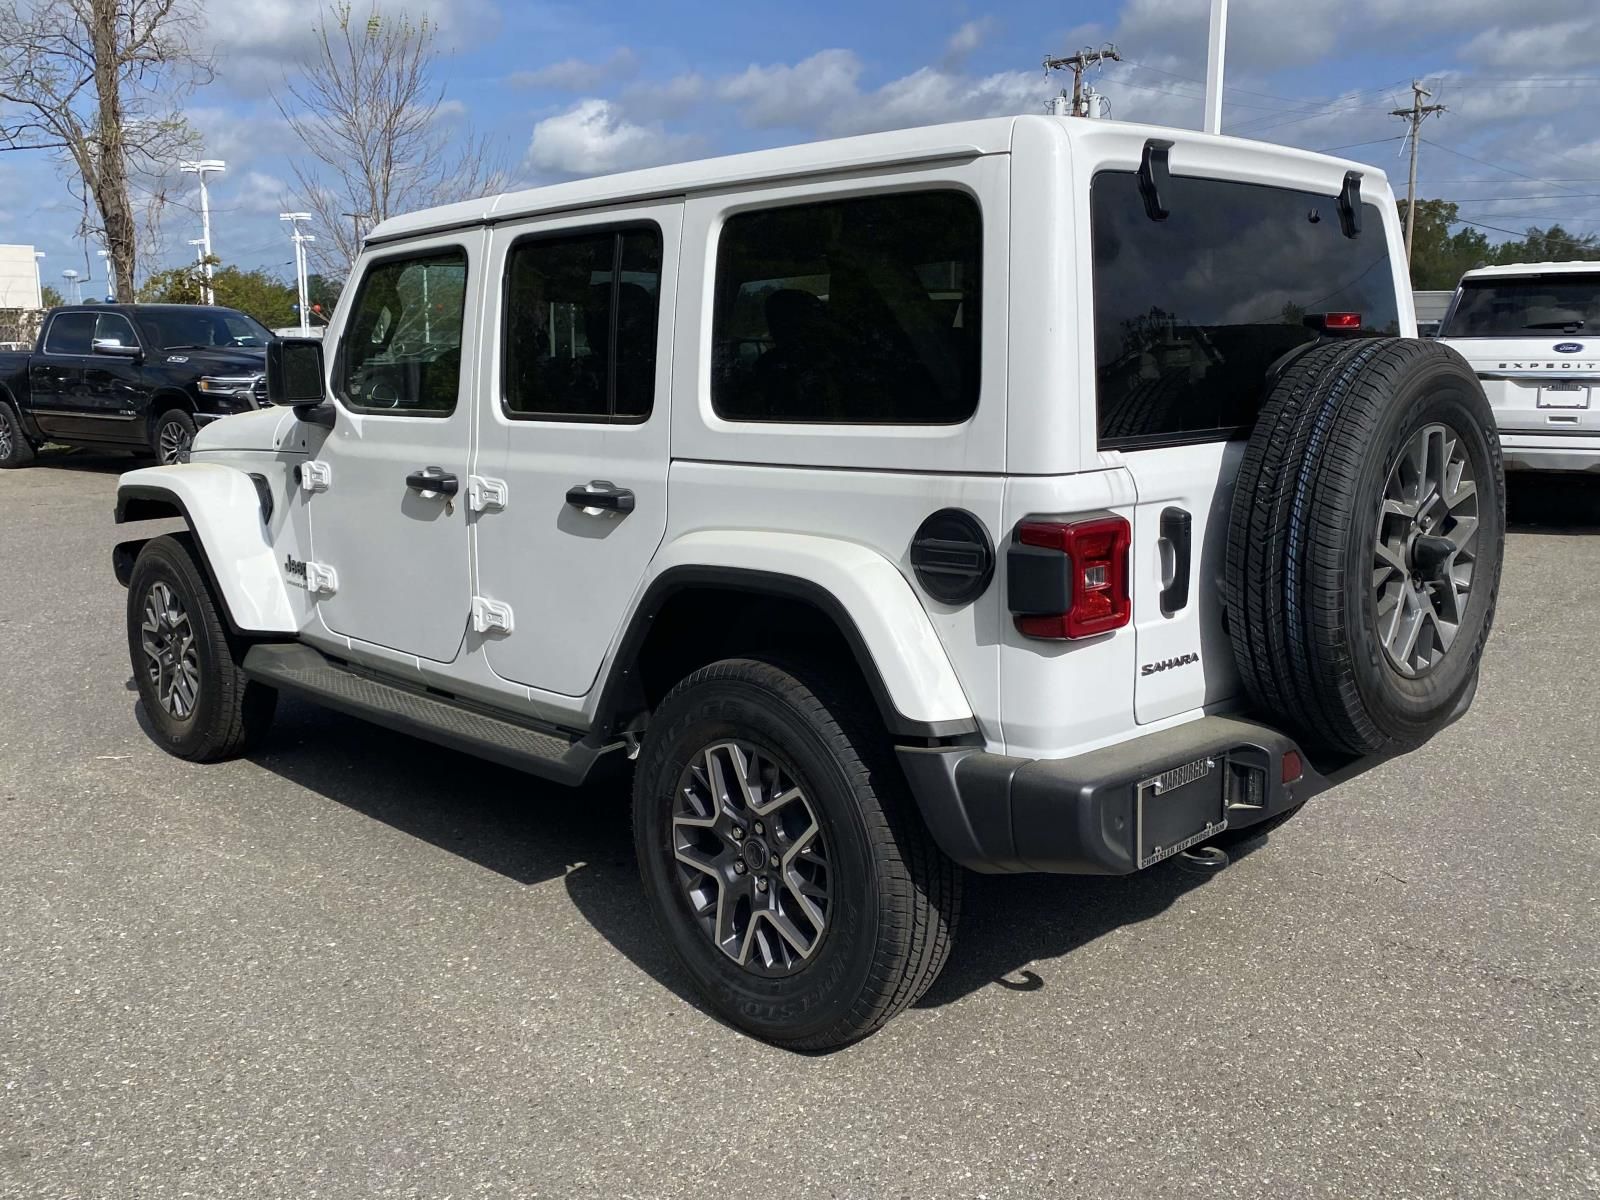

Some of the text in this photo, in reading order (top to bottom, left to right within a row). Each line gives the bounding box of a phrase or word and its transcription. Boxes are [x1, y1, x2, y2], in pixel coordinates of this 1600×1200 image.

[1557, 343, 1580, 352] Ford
[1141, 652, 1199, 677] SAHARA
[1142, 822, 1225, 867] CHRYSLER JEEP DODGE RAM
